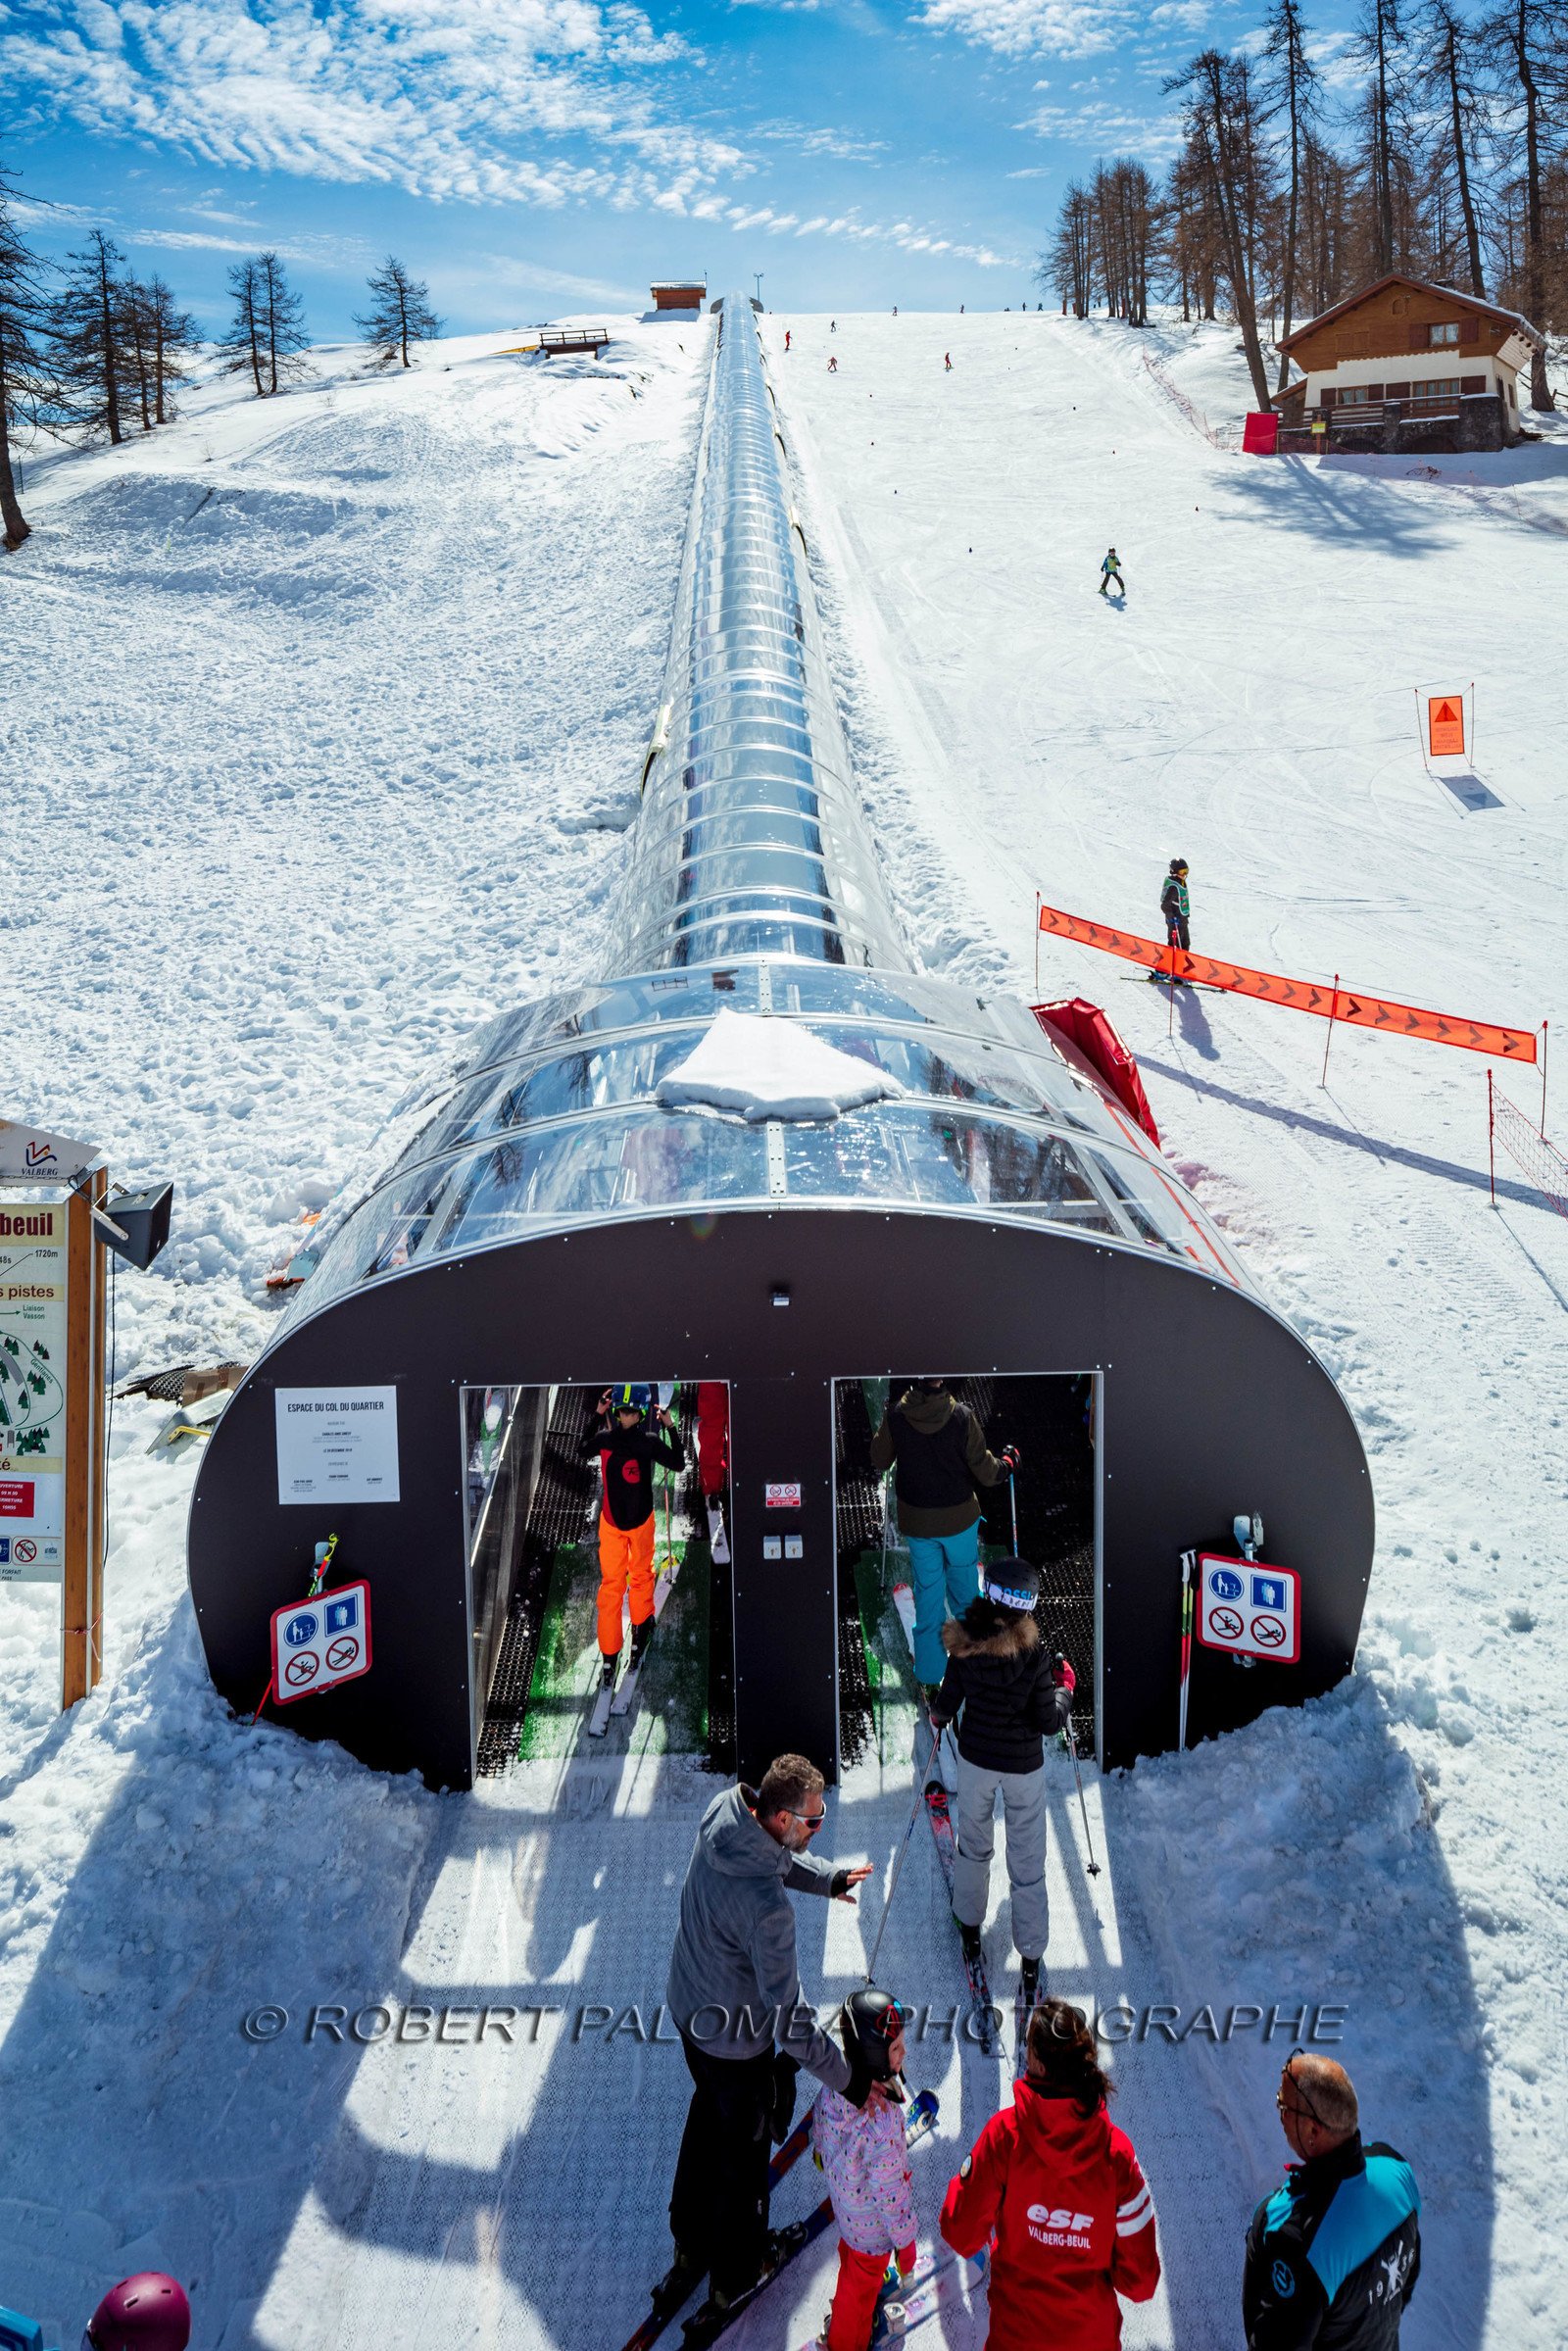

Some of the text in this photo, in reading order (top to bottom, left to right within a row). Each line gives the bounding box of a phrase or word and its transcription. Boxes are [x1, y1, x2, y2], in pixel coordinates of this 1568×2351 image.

[22, 1167, 59, 1176] VALBERG
[0, 1212, 53, 1236] beuil
[35, 1249, 58, 1258] 1720m
[9, 1285, 55, 1300] pistes
[30, 1358, 54, 1384] Gentianes
[288, 1401, 384, 1412] ESPACE DU COL DU QUARTIER
[1028, 2225, 1092, 2250] VALBERG-BEUIL
